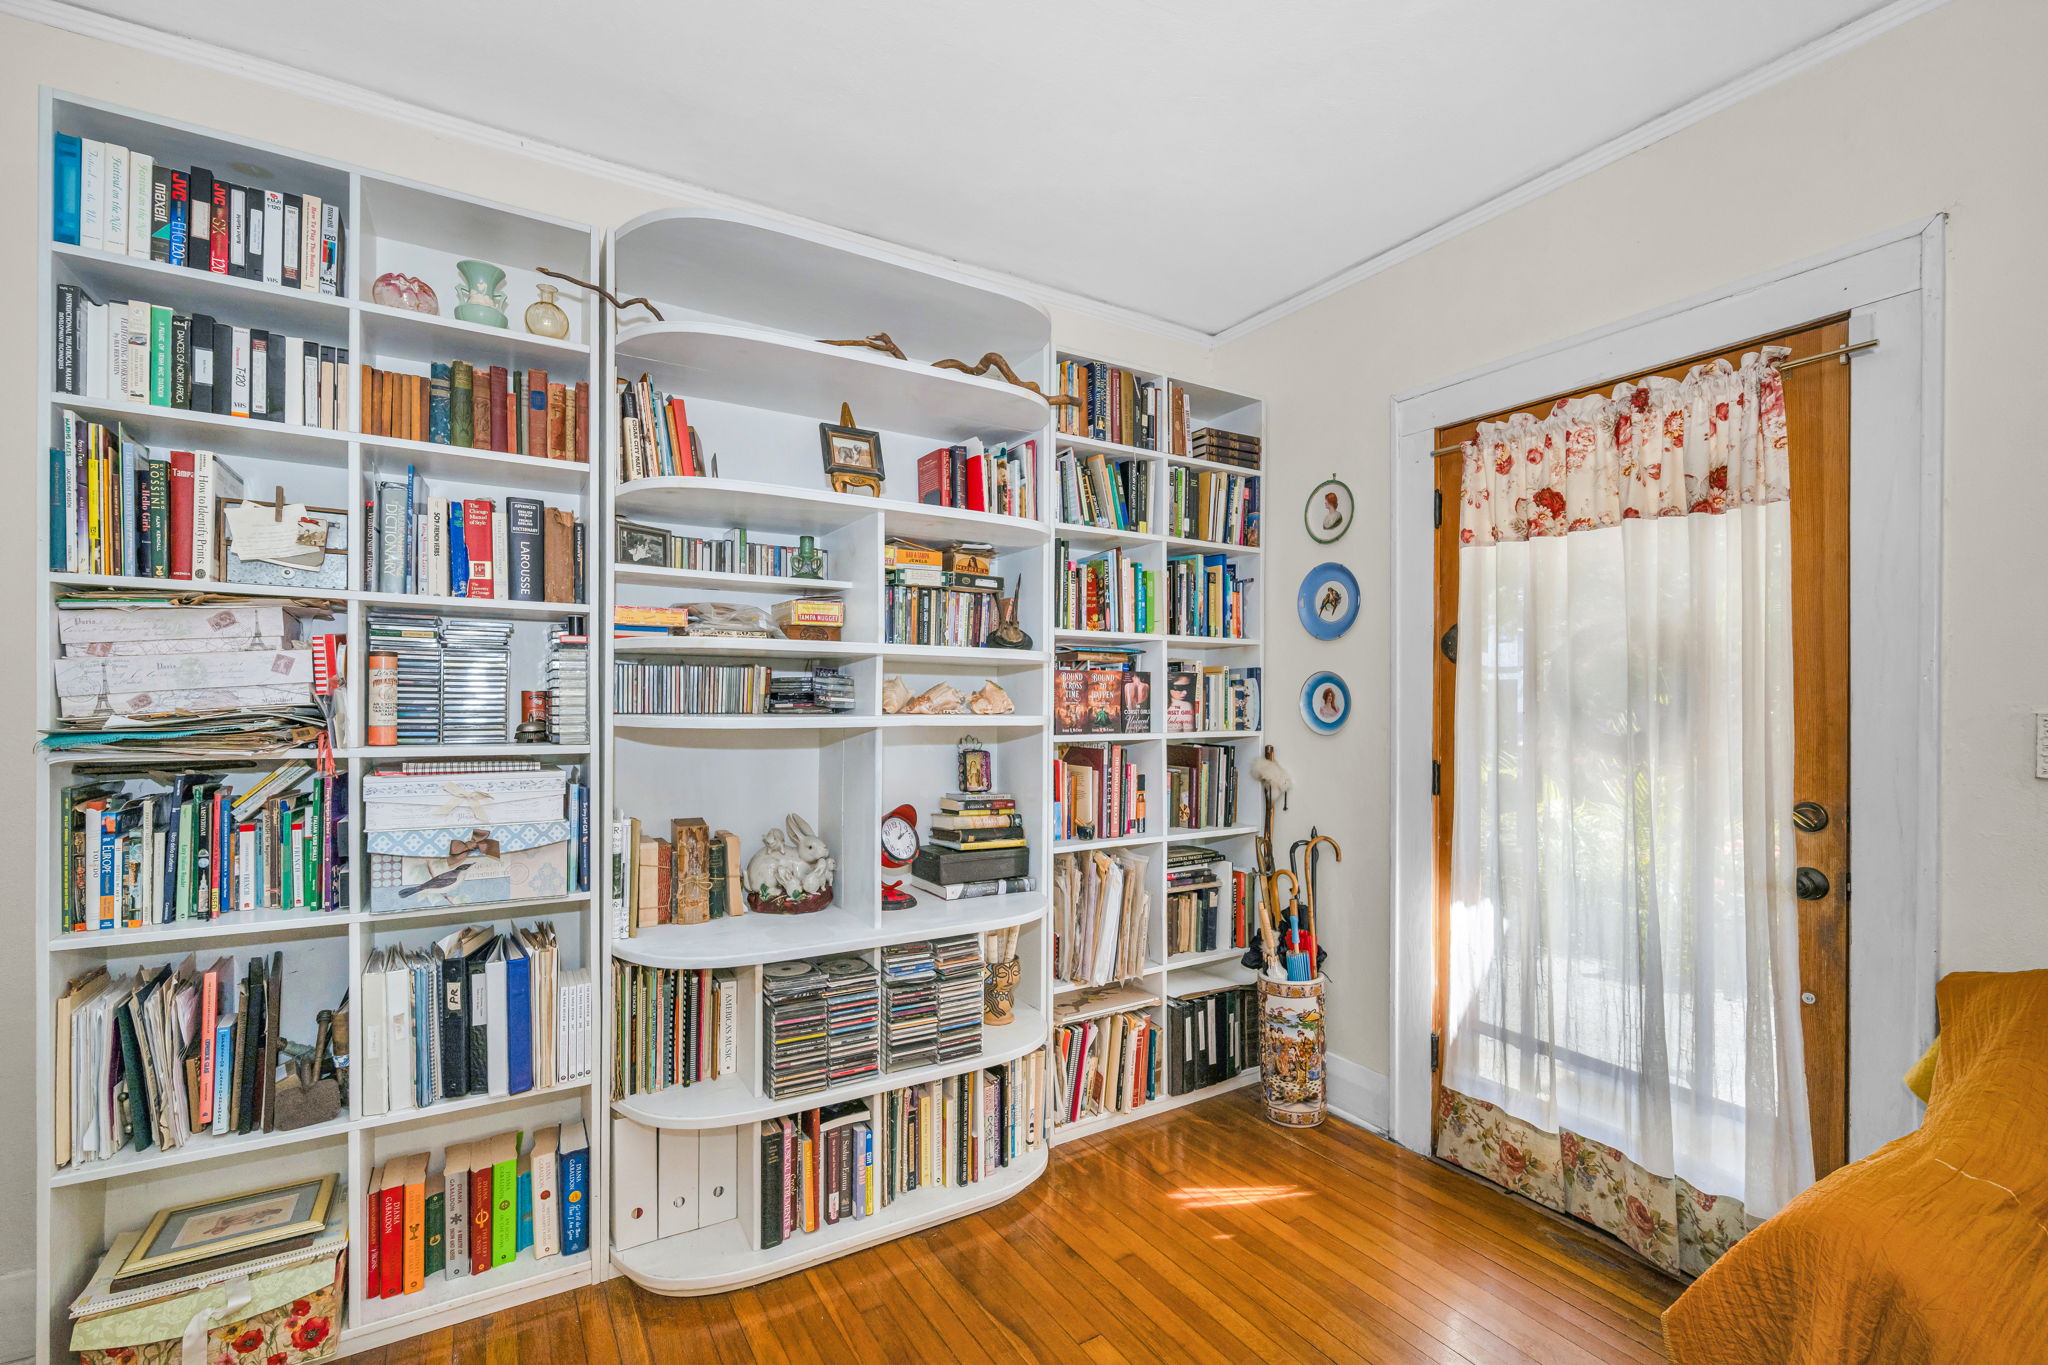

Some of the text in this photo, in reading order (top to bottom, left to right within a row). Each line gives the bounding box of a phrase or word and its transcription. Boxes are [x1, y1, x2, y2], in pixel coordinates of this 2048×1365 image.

[111, 157, 122, 232] Festival on the Nile
[172, 174, 186, 200] JVC
[214, 184, 225, 204] JVC
[154, 183, 167, 222] maxell
[212, 258, 225, 274] 120
[120, 318, 128, 393] FLATFOOTING WORKSHOP
[176, 330, 185, 403] DANCES OF NORTH AFRICA
[141, 490, 150, 510] Hello
[150, 464, 160, 510] ROSSINI
[142, 512, 150, 532] Girls
[196, 475, 208, 564] How to Identify Prints
[384, 504, 397, 576] DICTIONARY
[520, 542, 530, 594] LAROUSSE
[799, 614, 816, 622] TAMPA
[1062, 672, 1083, 681] BOUND
[1092, 674, 1115, 682] BOUND
[102, 845, 113, 873] EUROPE
[449, 989, 459, 1004] PR
[385, 1197, 393, 1234] GABALDON
